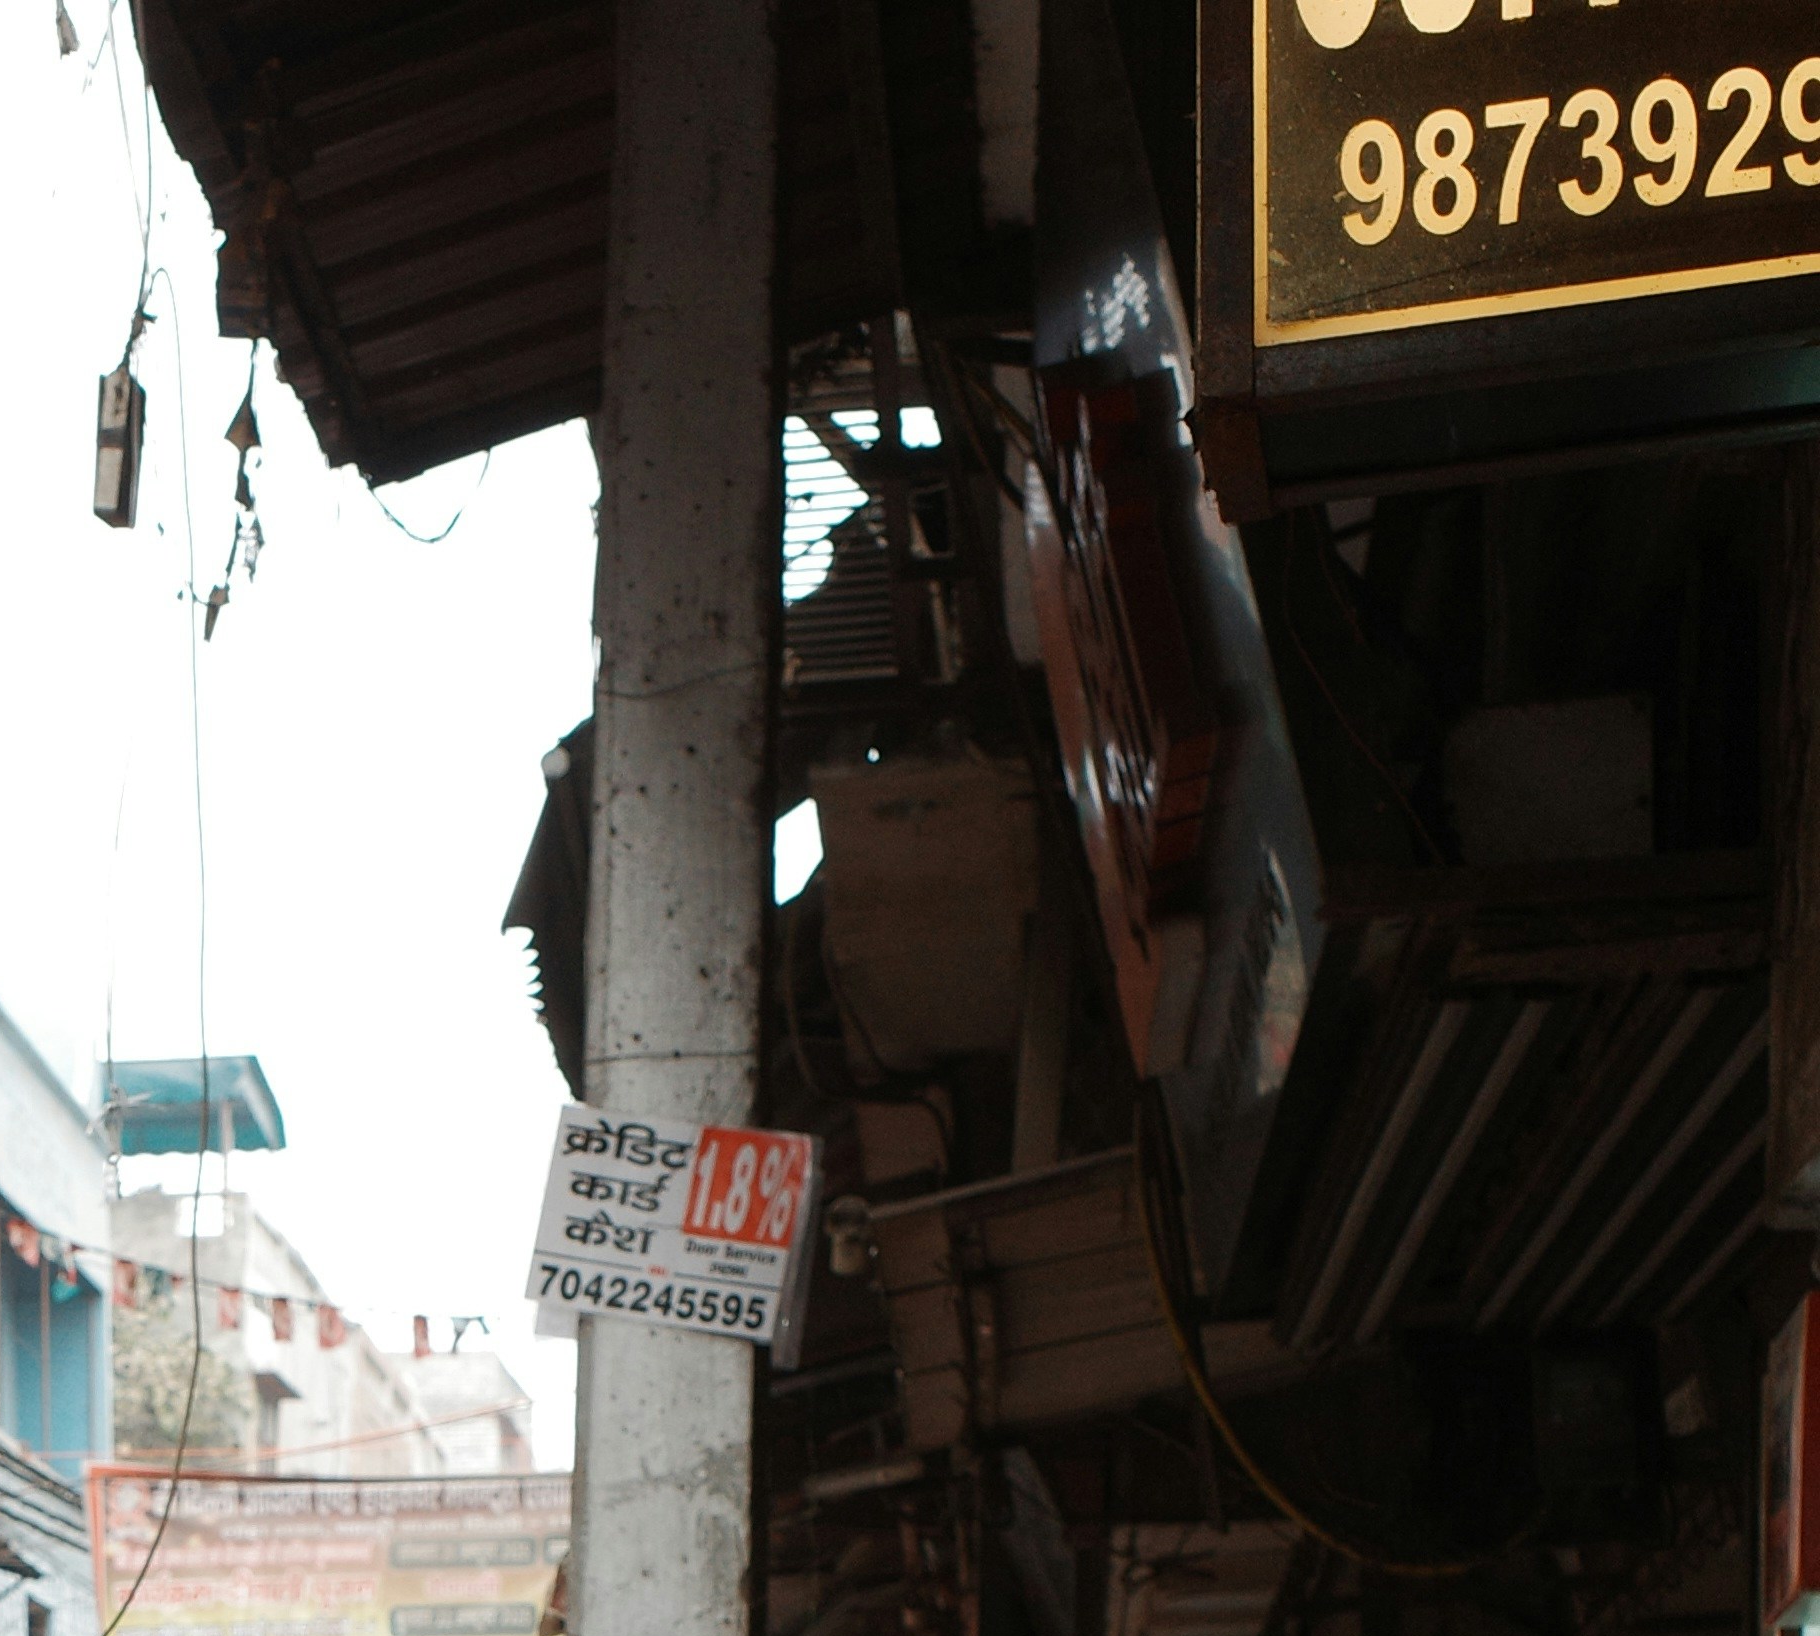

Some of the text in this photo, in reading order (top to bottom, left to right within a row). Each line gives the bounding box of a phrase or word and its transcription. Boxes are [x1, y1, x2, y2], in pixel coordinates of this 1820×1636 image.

[1339, 56, 1820, 247] 9873929
[562, 1118, 694, 1171] क्रेडिट
[570, 1170, 671, 1213] कार्ड
[689, 1140, 802, 1243] 1.8%
[539, 1264, 767, 1330] 7042245595
